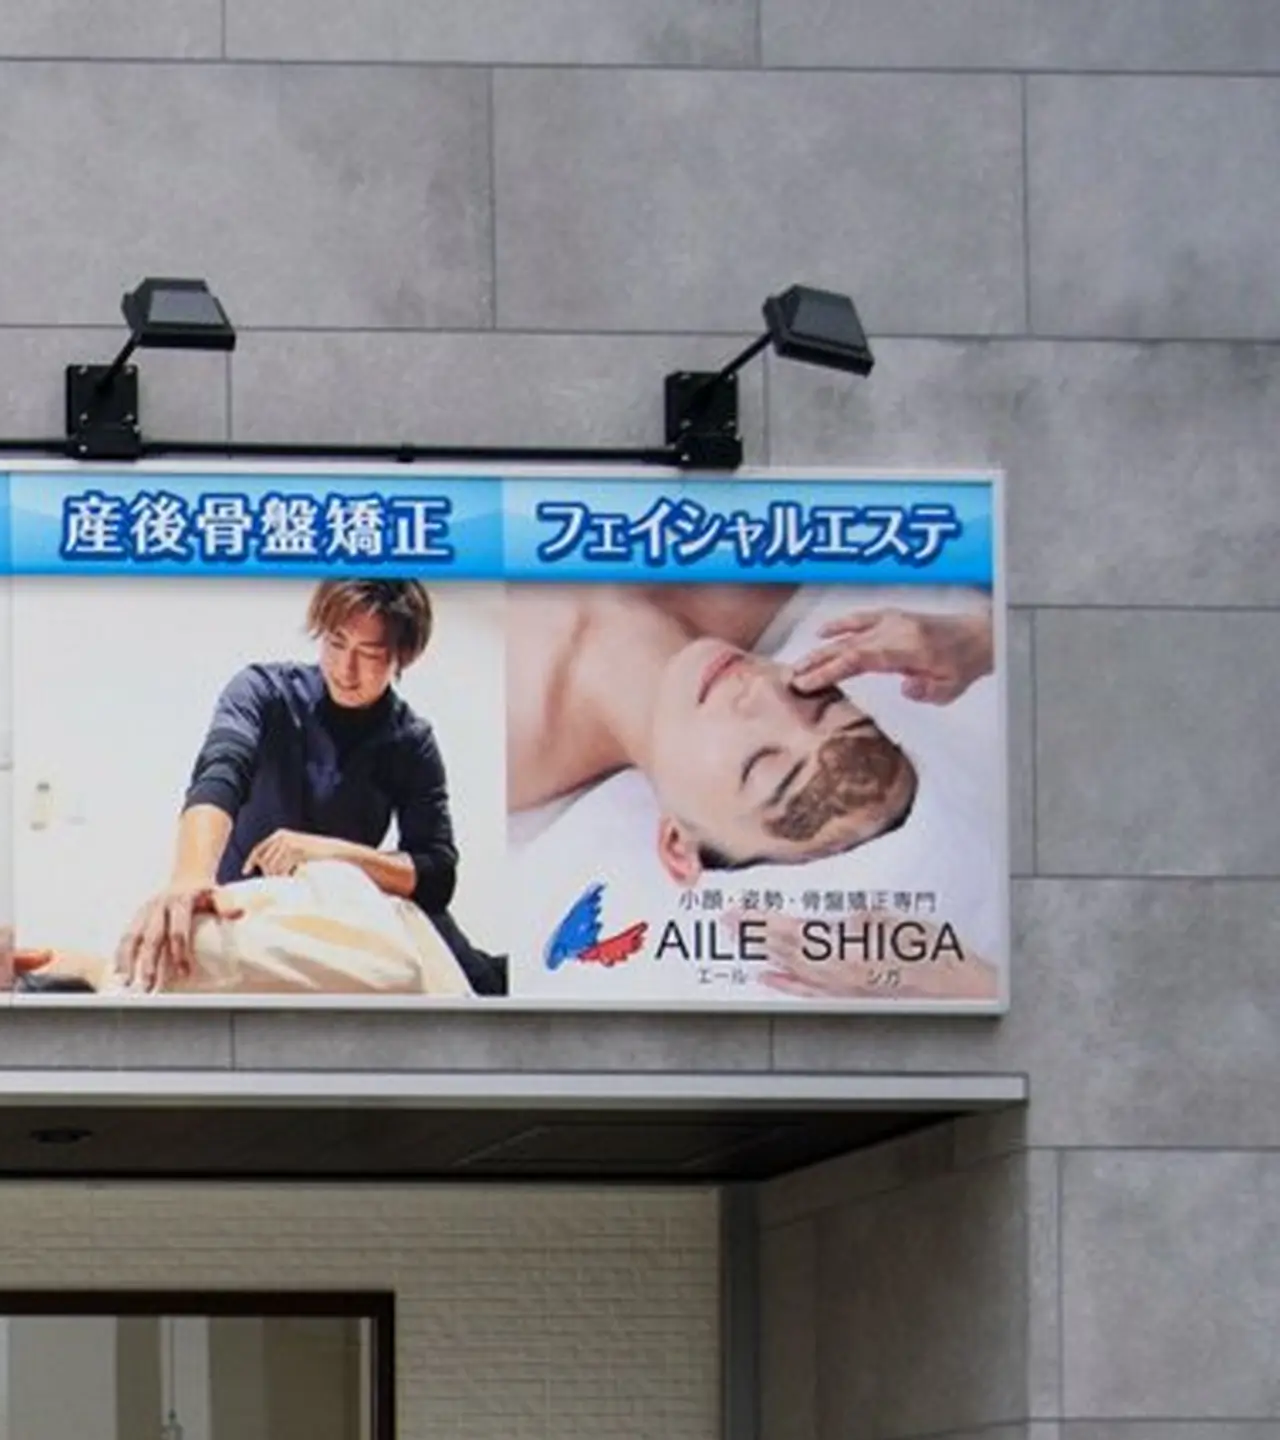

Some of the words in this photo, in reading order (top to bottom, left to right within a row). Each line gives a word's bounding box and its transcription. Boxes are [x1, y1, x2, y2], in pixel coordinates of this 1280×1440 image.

[63, 493, 452, 559] 産後骨盤矯正
[540, 500, 958, 562] フェイシャルエステ
[655, 919, 768, 961] AILE
[801, 920, 965, 962] SHIGA
[697, 968, 748, 984] エール
